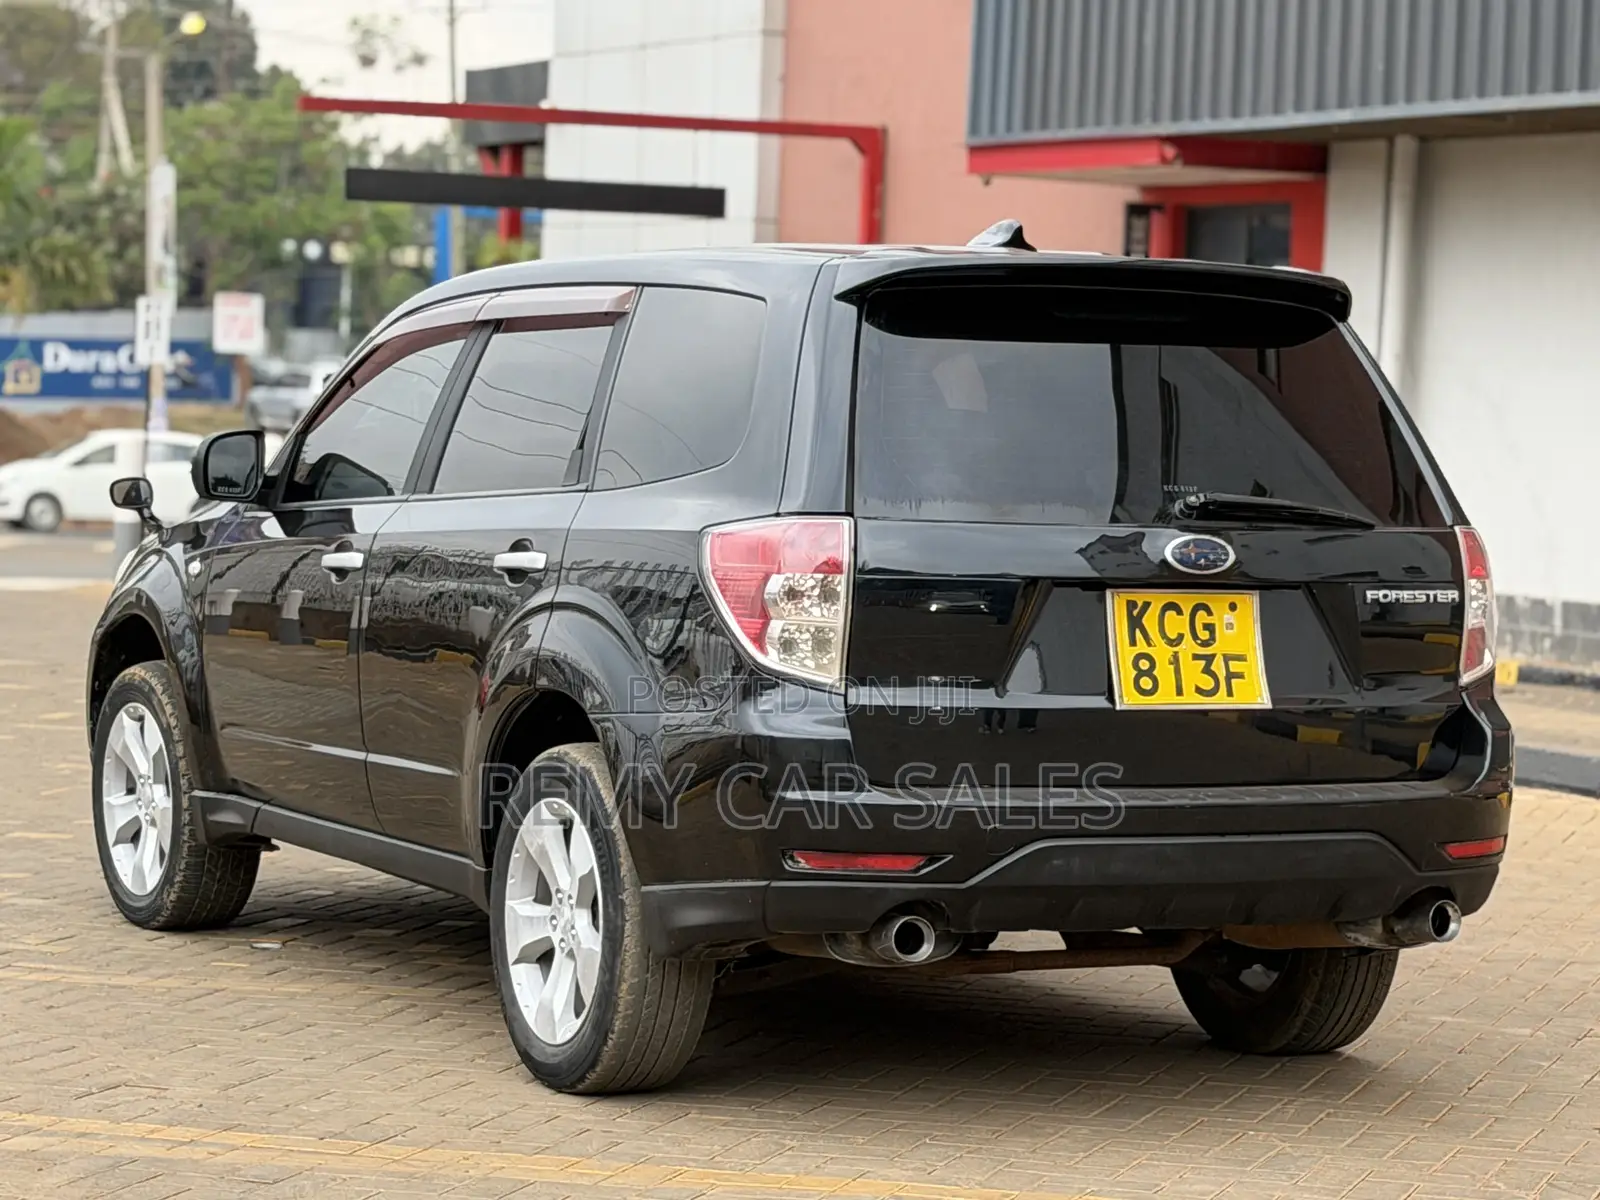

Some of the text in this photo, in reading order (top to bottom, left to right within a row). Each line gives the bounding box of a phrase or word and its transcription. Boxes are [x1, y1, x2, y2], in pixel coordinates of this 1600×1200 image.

[1365, 588, 1460, 604] FORESTER
[1126, 600, 1217, 649] KCG
[1132, 651, 1249, 699] 813F
